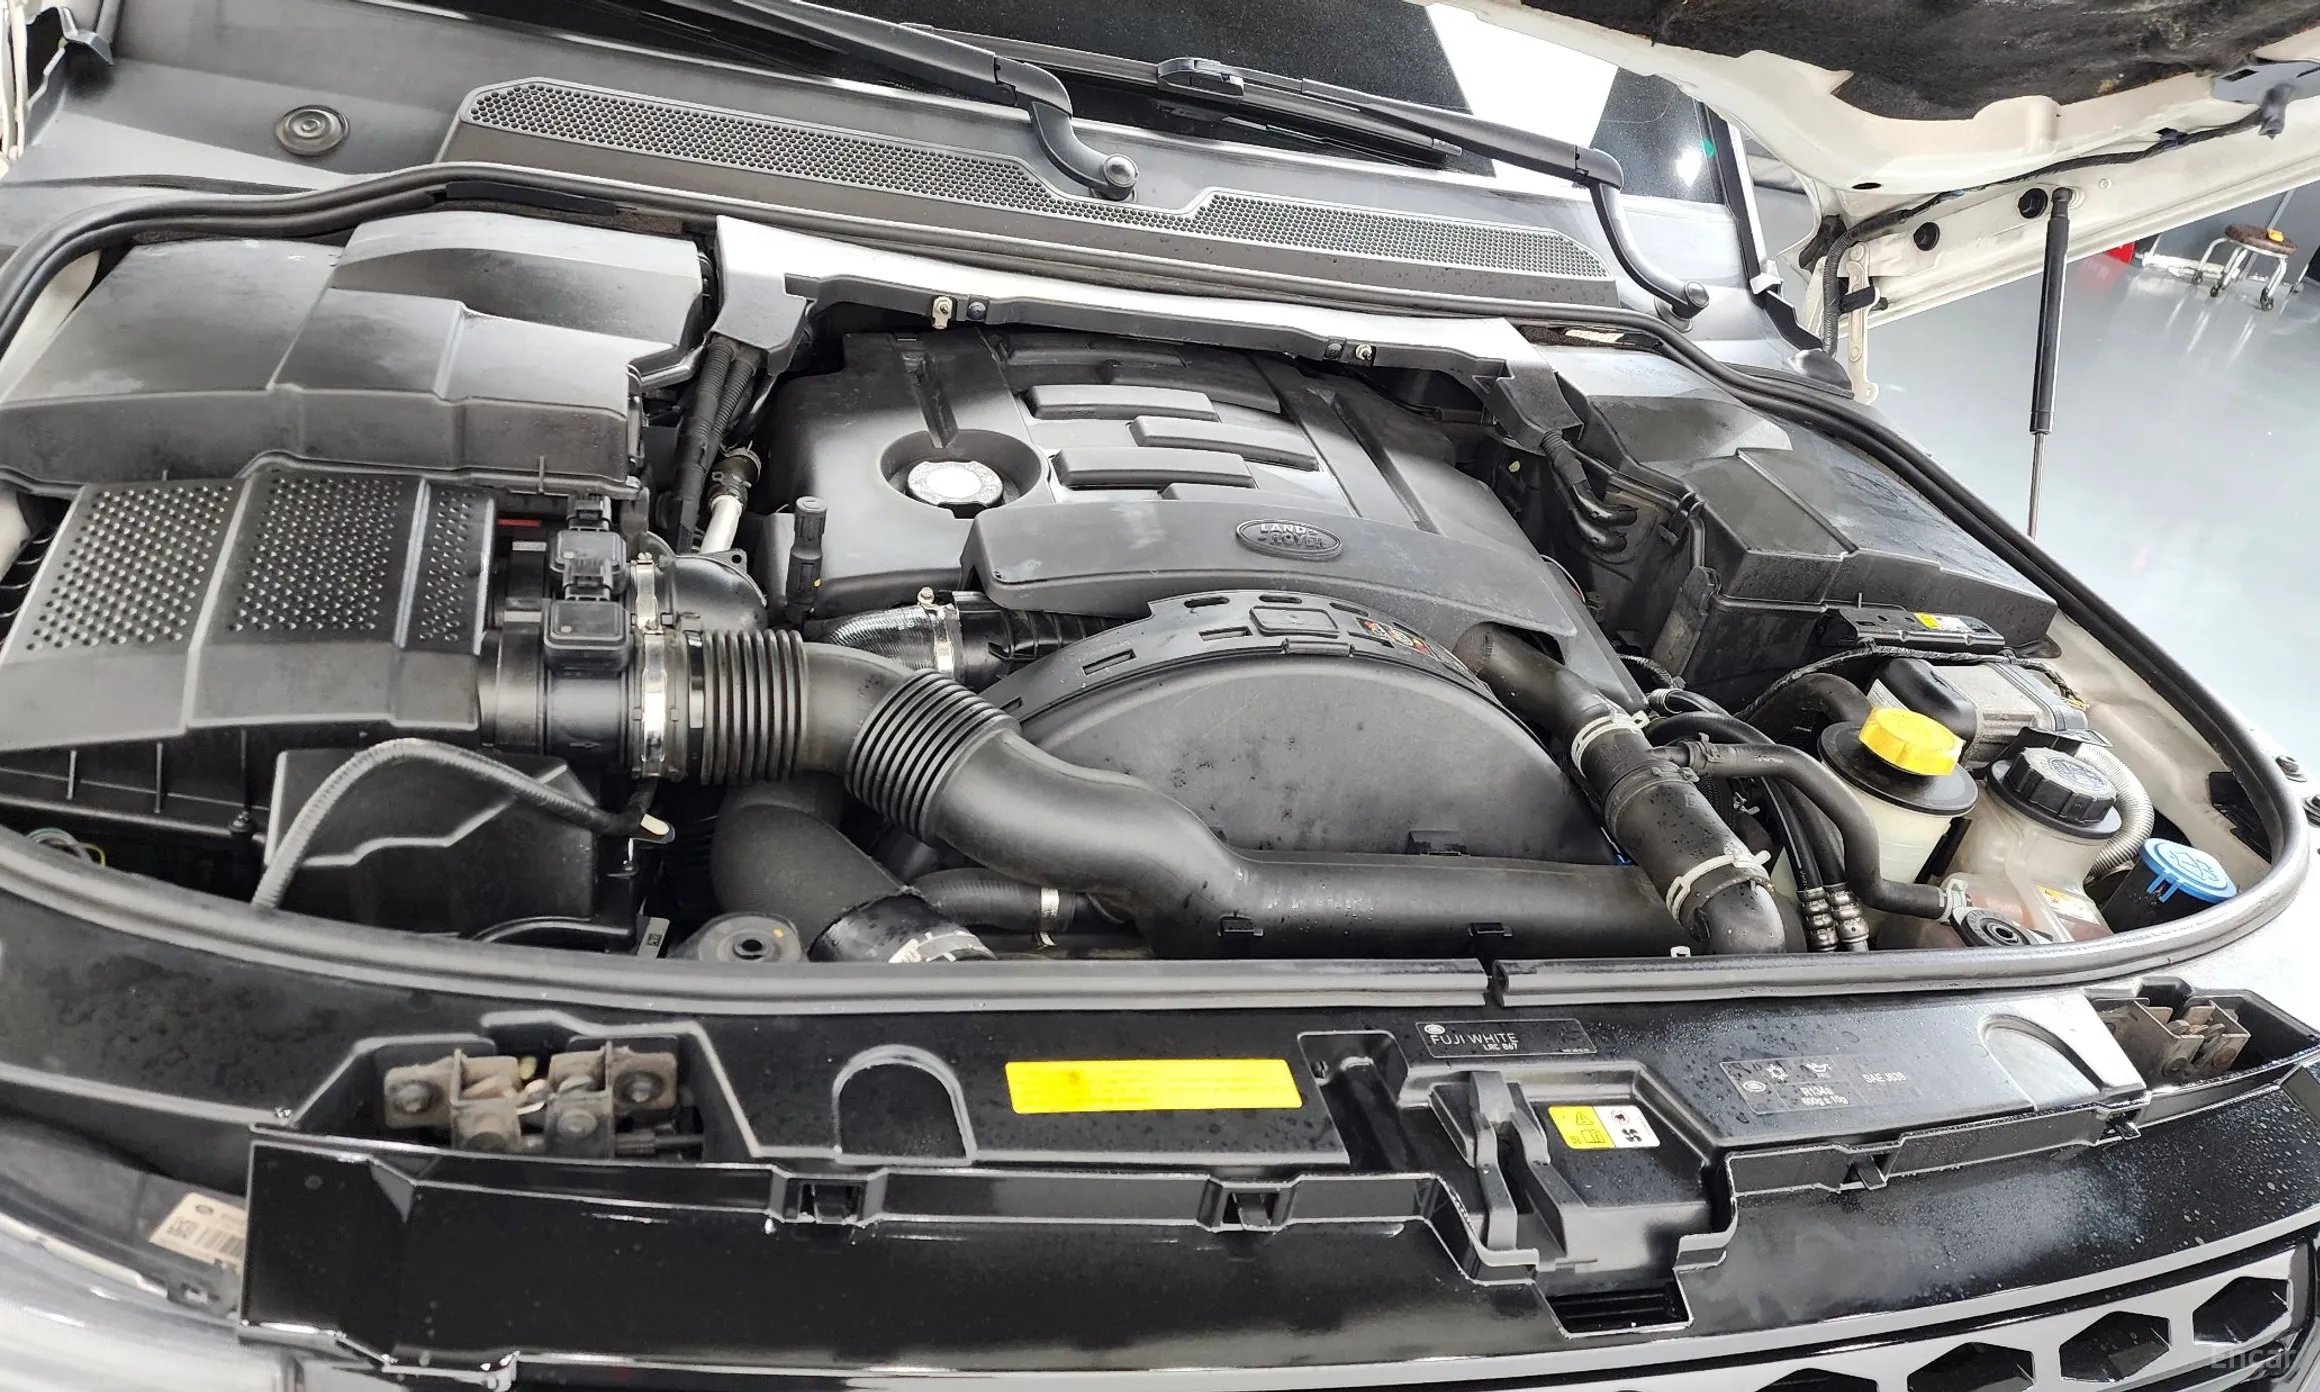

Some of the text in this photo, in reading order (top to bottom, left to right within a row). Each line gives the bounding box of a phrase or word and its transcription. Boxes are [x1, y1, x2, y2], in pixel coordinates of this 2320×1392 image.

[1260, 523, 1307, 534] LAND
[1430, 1032, 1519, 1045] FUJI WHITE
